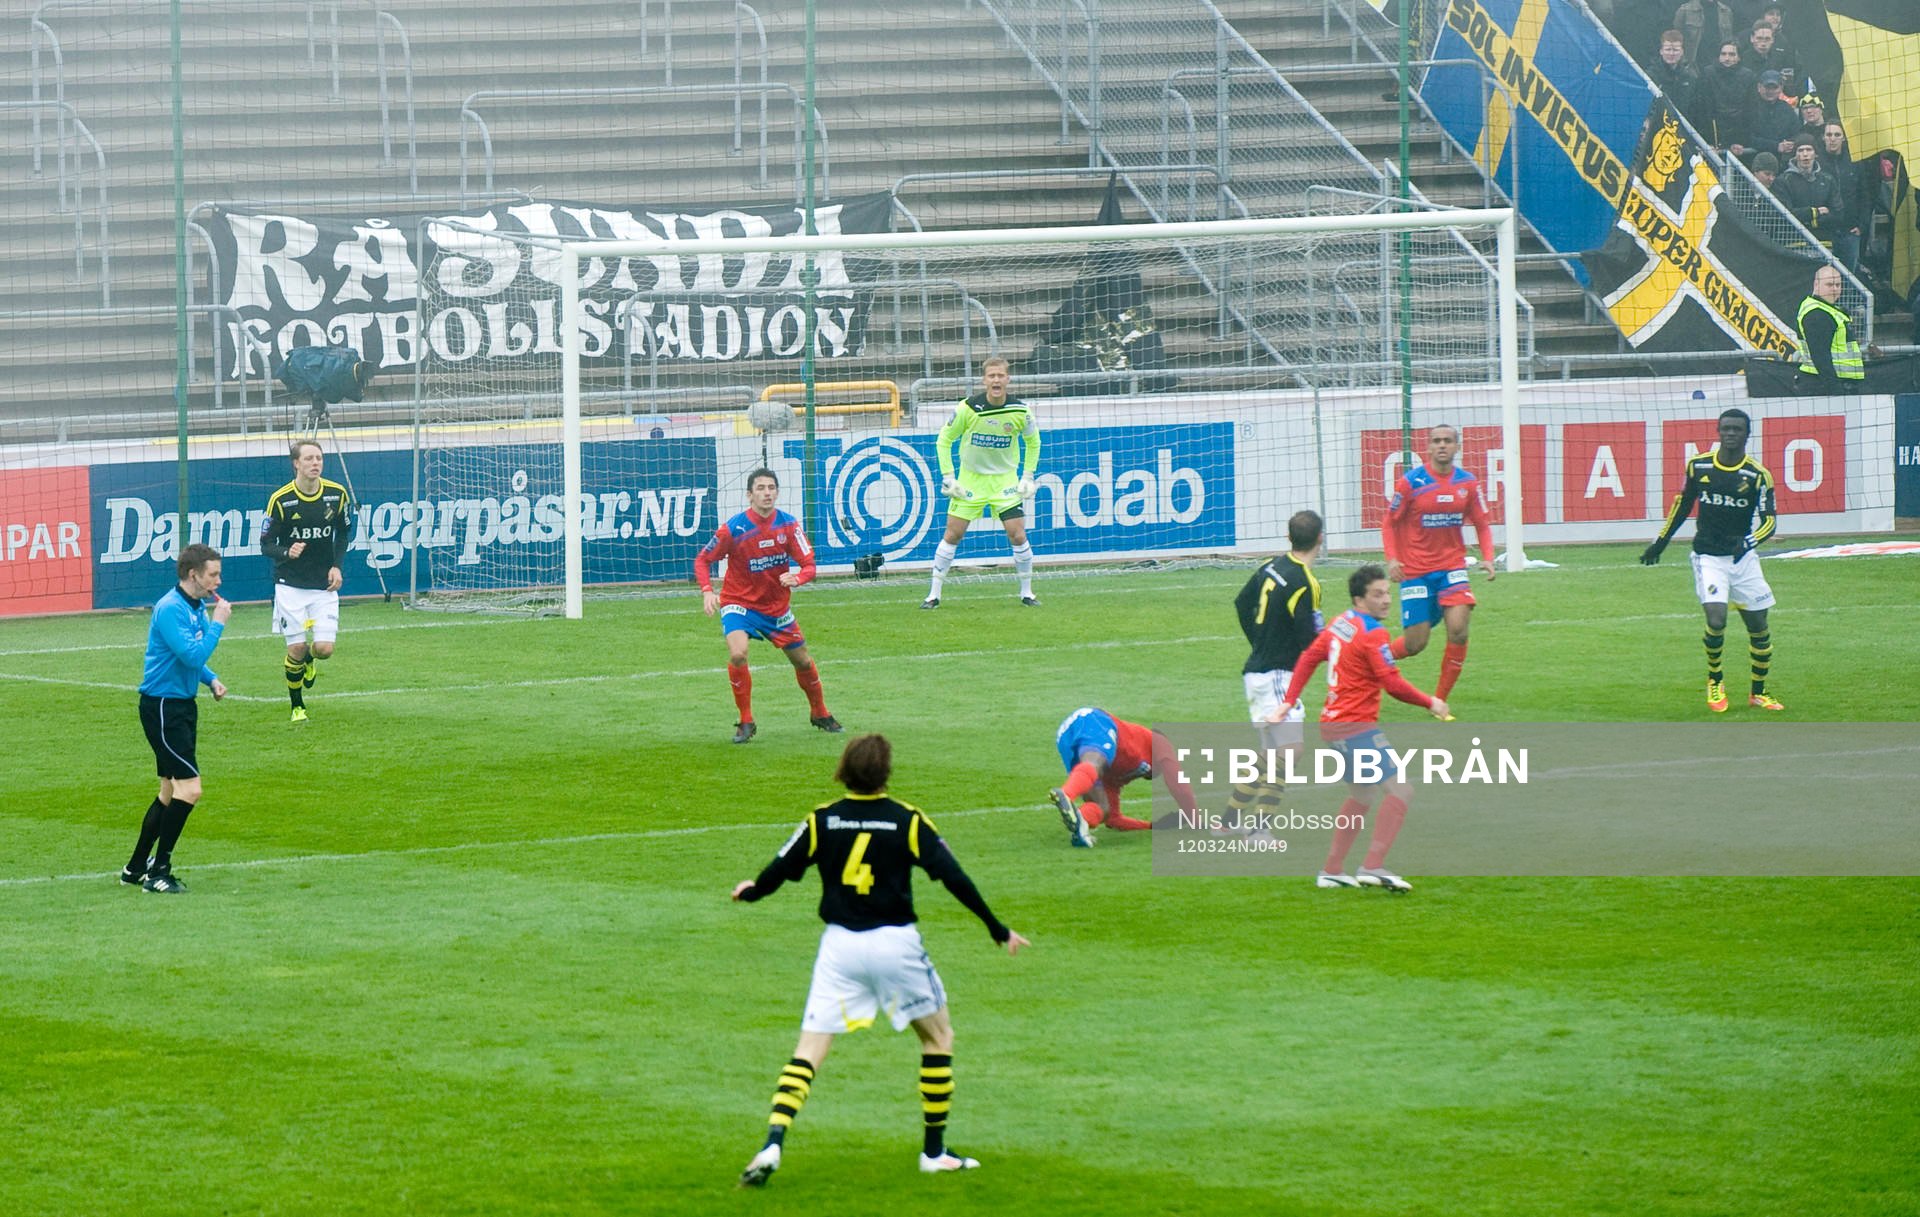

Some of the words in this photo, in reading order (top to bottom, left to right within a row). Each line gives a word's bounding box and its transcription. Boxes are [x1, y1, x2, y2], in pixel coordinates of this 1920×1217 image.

[1449, 0, 1498, 67] SOL
[1500, 47, 1622, 198] INVICTUS
[226, 203, 853, 311] RÅSUNDA
[968, 448, 1205, 531] ndab
[0, 521, 82, 561] PAR
[841, 831, 875, 896] 4
